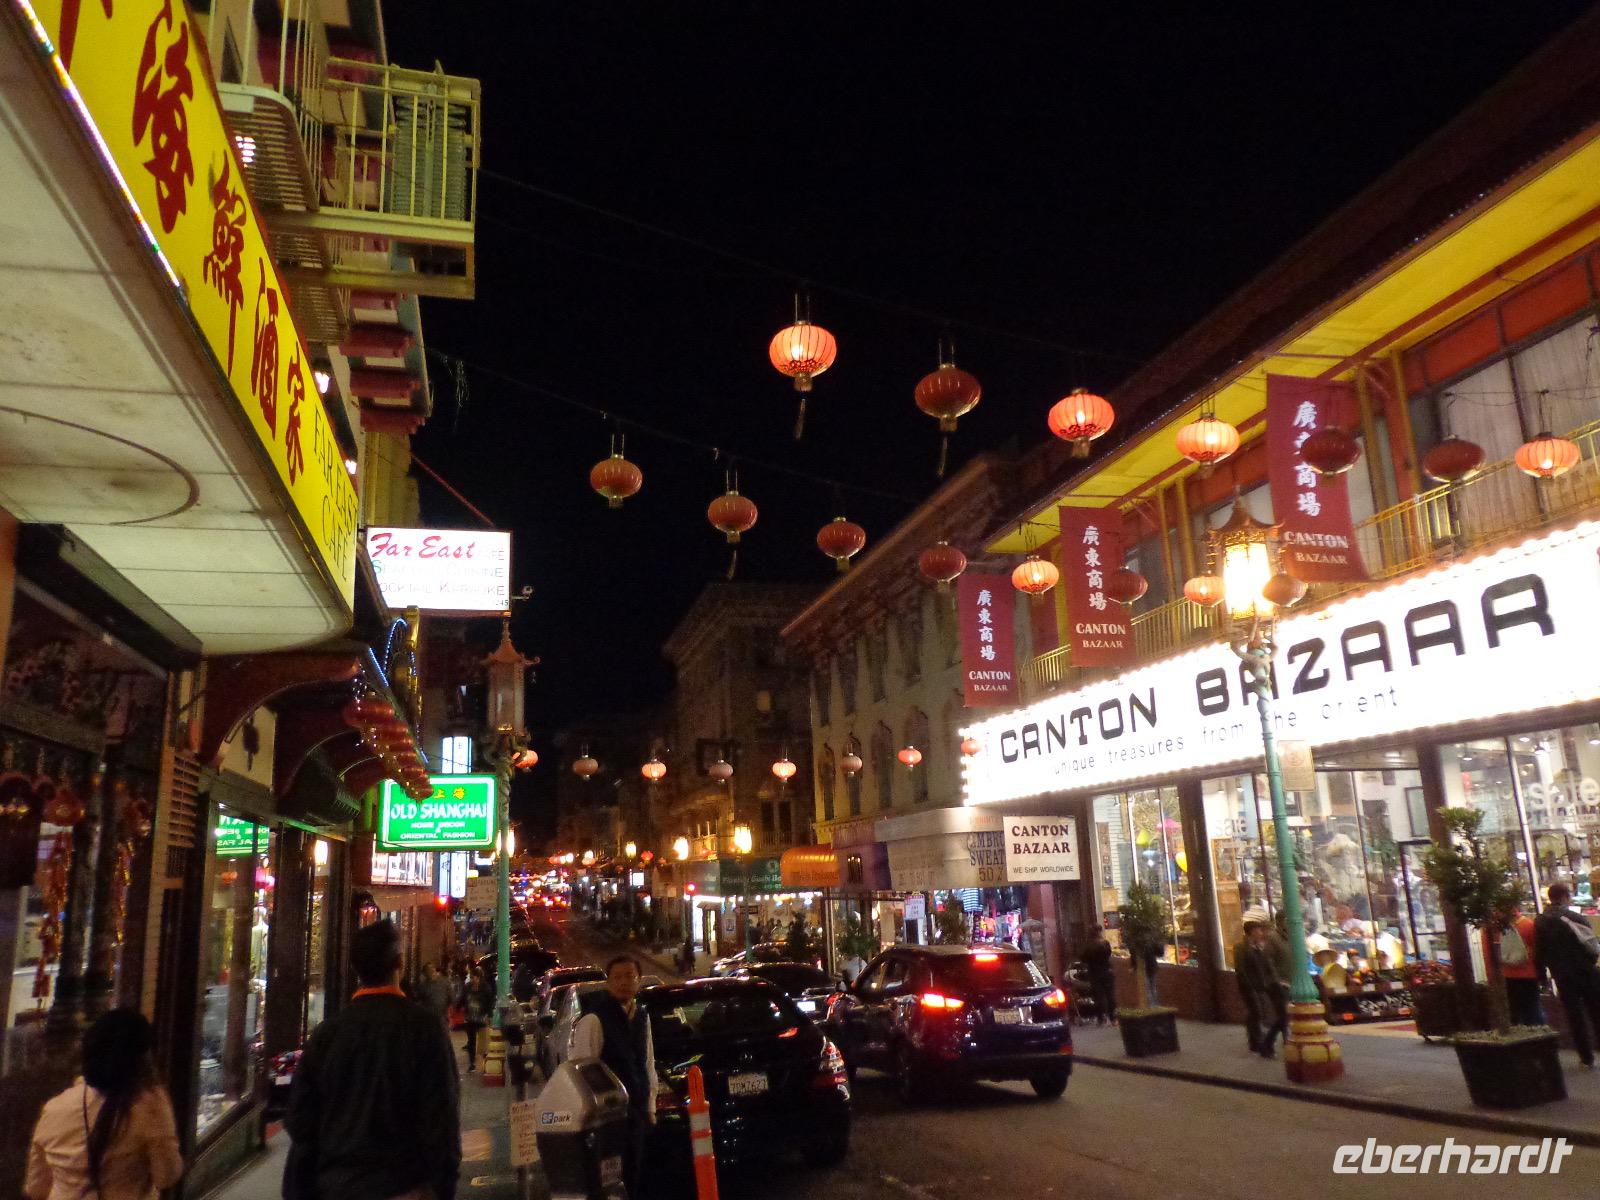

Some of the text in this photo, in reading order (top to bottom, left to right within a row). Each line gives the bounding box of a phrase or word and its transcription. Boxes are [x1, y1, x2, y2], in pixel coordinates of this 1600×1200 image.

[314, 405, 357, 545] FAR EAST
[322, 494, 348, 582] CAFE
[370, 532, 413, 558] Far
[418, 535, 476, 559] East
[1283, 530, 1349, 549] CANTON
[1295, 551, 1349, 565] BAZAAR
[1082, 525, 1107, 611] 廣東商場
[379, 581, 433, 594] OCKTAIL
[976, 589, 997, 661] 廣東商場
[1075, 623, 1126, 635] CANTON
[1082, 639, 1124, 649] BAZAAR
[968, 670, 1011, 681] CANTON
[1000, 573, 1556, 764] CANTON BAZAAR
[973, 684, 1009, 692] BAZAAR
[1053, 753, 1096, 776] unique
[1108, 734, 1185, 765] treasures
[1202, 721, 1244, 745] from
[1263, 710, 1297, 732] he
[390, 802, 487, 820] OLD SHANGHAI
[1011, 825, 1069, 837] CANTON
[1013, 842, 1071, 855] BAZAAR
[1040, 865, 1074, 873] WORLDWIDE
